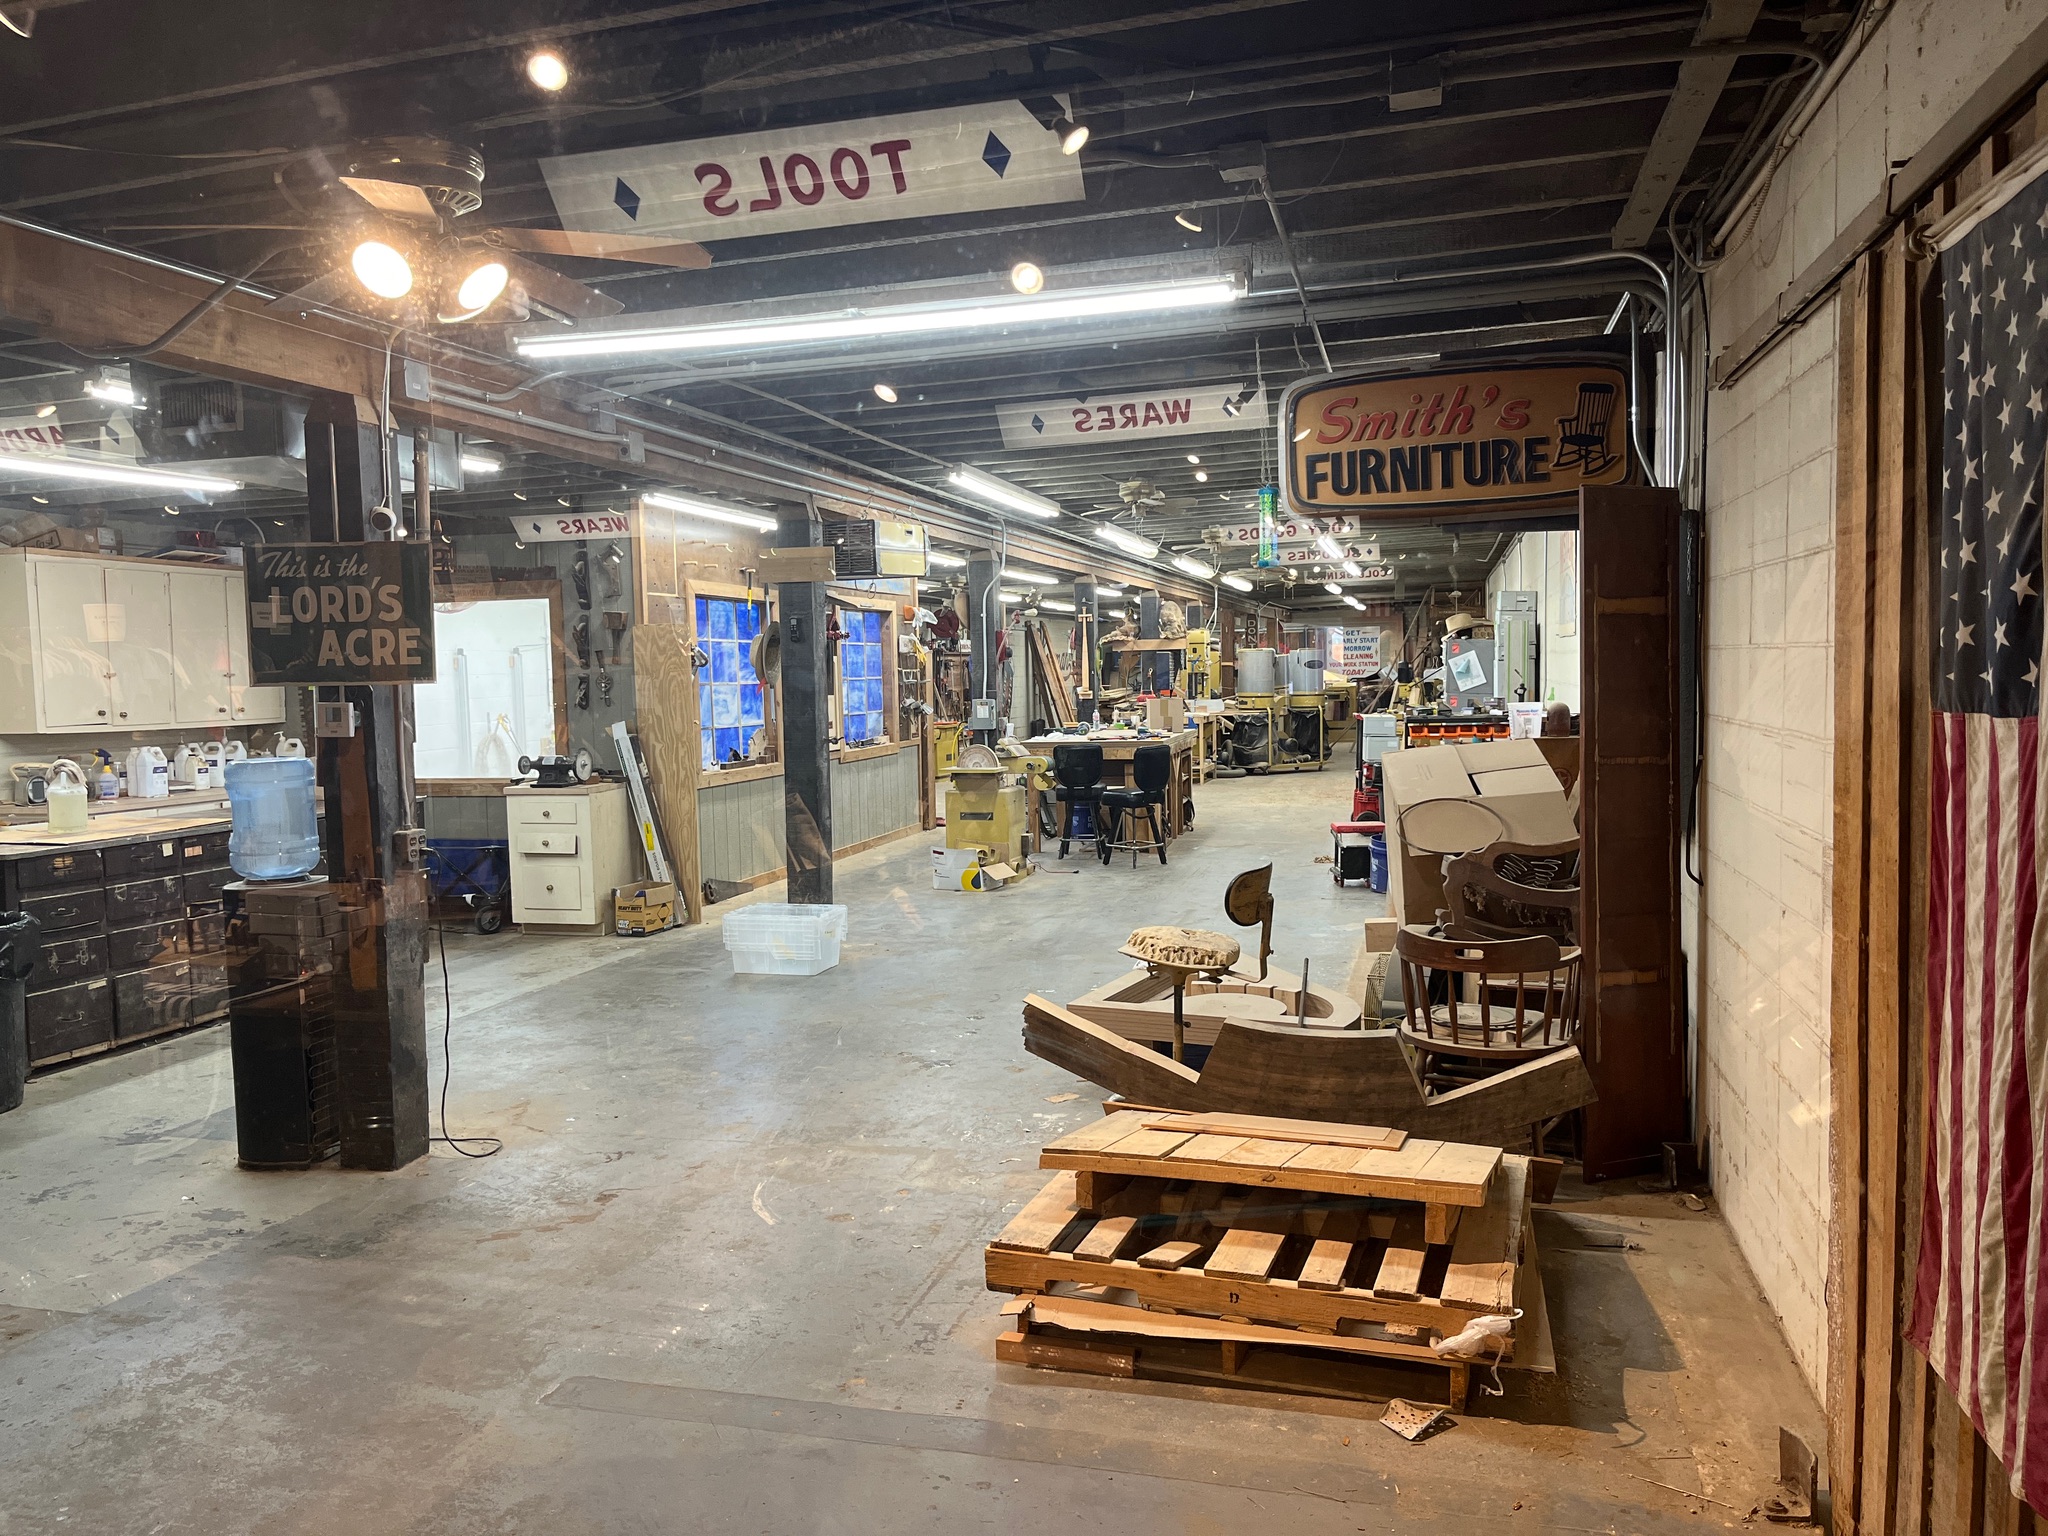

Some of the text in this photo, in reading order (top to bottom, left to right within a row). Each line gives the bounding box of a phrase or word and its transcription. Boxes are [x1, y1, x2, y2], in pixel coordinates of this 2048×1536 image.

[1315, 384, 1531, 444] Smith's
[1305, 435, 1551, 500] FURNITURE
[257, 551, 369, 579] This is the
[270, 576, 403, 624] LORD'S
[317, 627, 422, 667] ACRE
